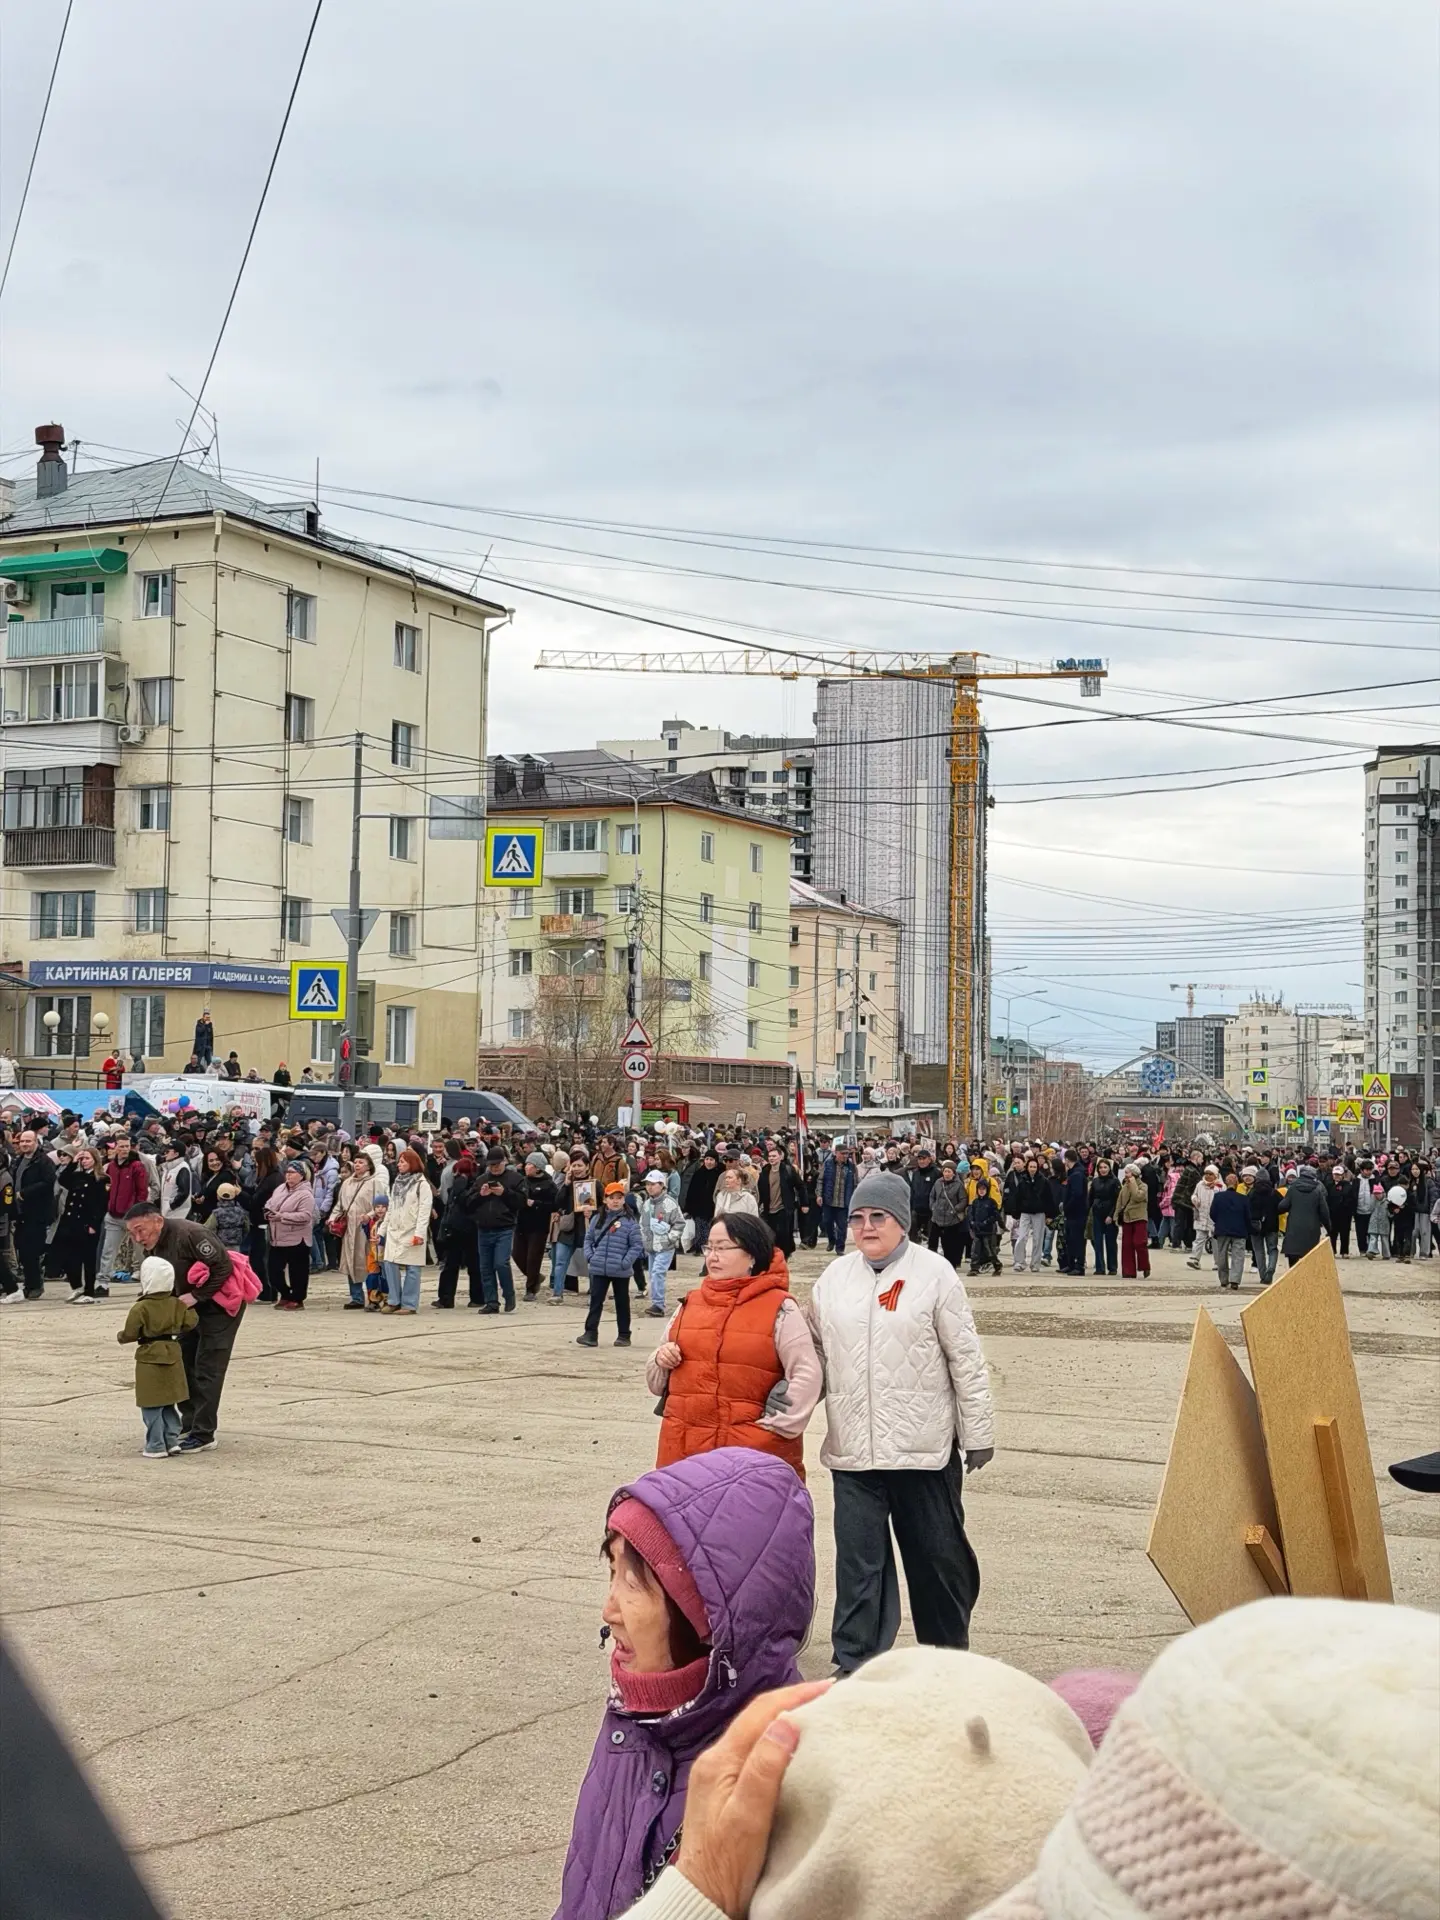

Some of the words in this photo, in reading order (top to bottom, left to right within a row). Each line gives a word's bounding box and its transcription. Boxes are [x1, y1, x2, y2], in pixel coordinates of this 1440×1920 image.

[46, 966, 128, 981] КАРТИННАЯ
[132, 967, 191, 982] ГАЛЕРЕЯ
[212, 970, 253, 983] АКАДЕМИКА
[628, 1061, 645, 1072] 40
[1370, 1106, 1385, 1117] 20
